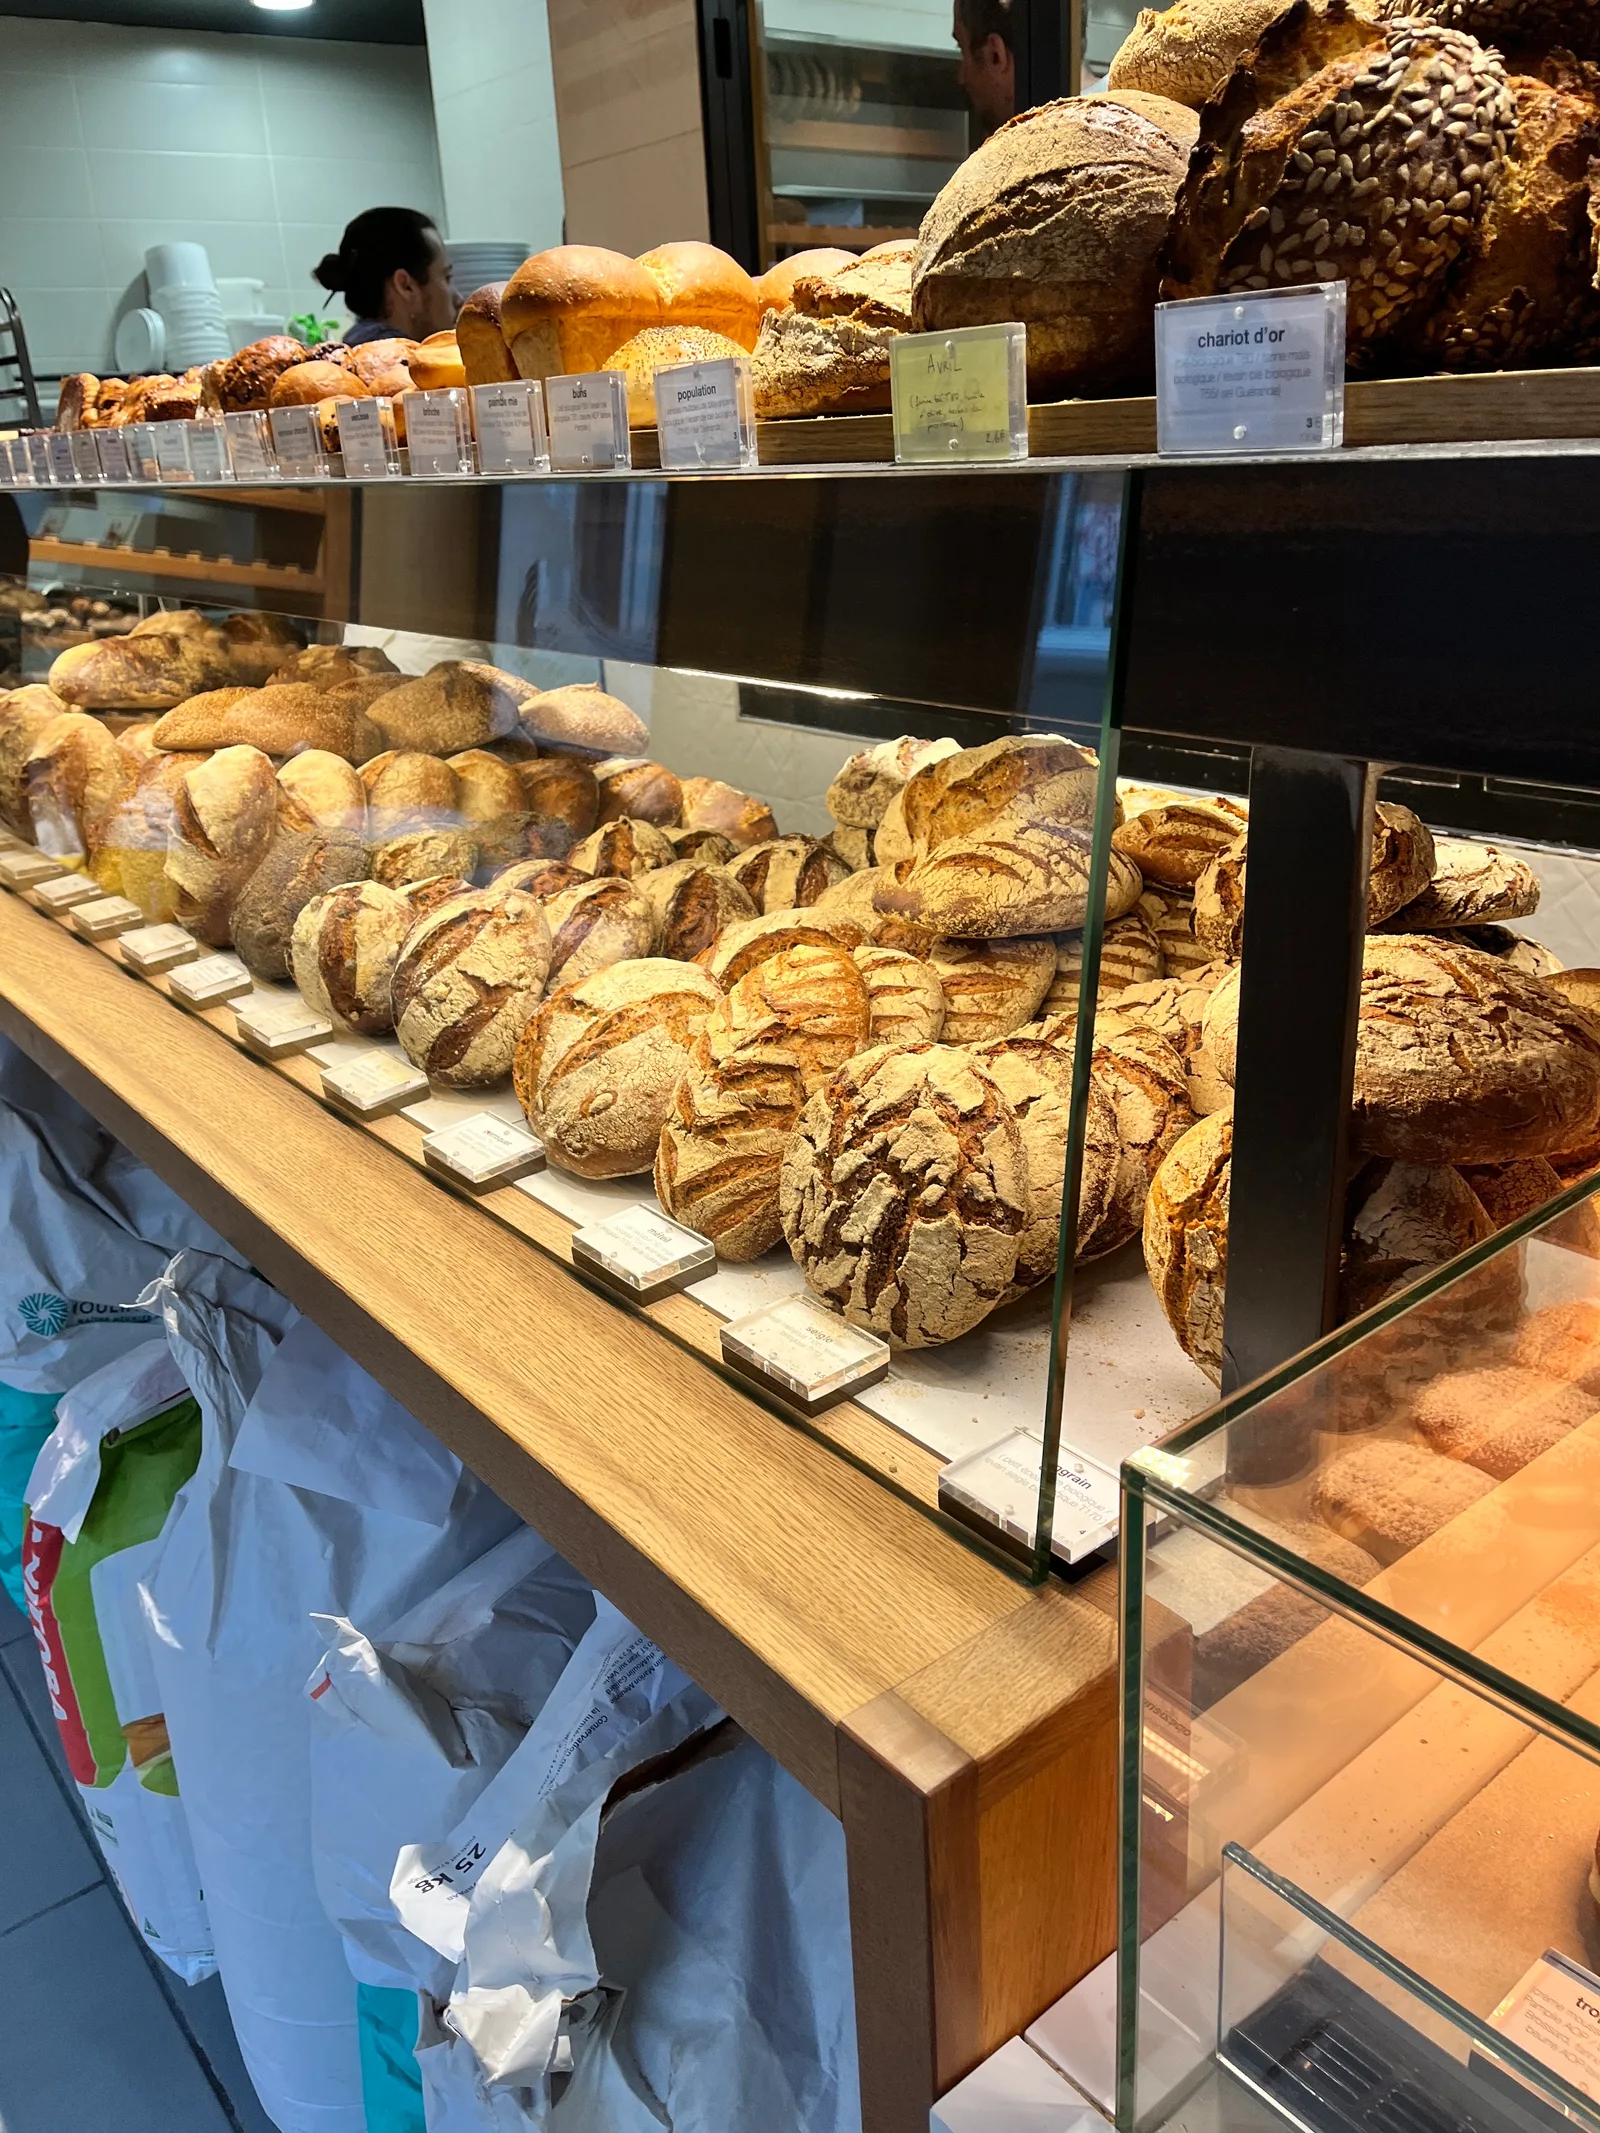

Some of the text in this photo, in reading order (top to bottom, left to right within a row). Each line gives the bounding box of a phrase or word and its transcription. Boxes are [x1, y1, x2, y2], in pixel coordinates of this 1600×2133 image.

[1198, 327, 1285, 348] chariot d'or
[677, 384, 717, 402] population
[1306, 417, 1313, 428] 3
[805, 1326, 834, 1344] seigle
[626, 1651, 641, 1664] Jean
[625, 1658, 648, 1677] Moulin
[633, 1665, 656, 1685] Marion
[566, 1715, 608, 1757] Conservation
[414, 1842, 487, 1894] 25 kg
[1575, 1996, 1600, 2024] tro
